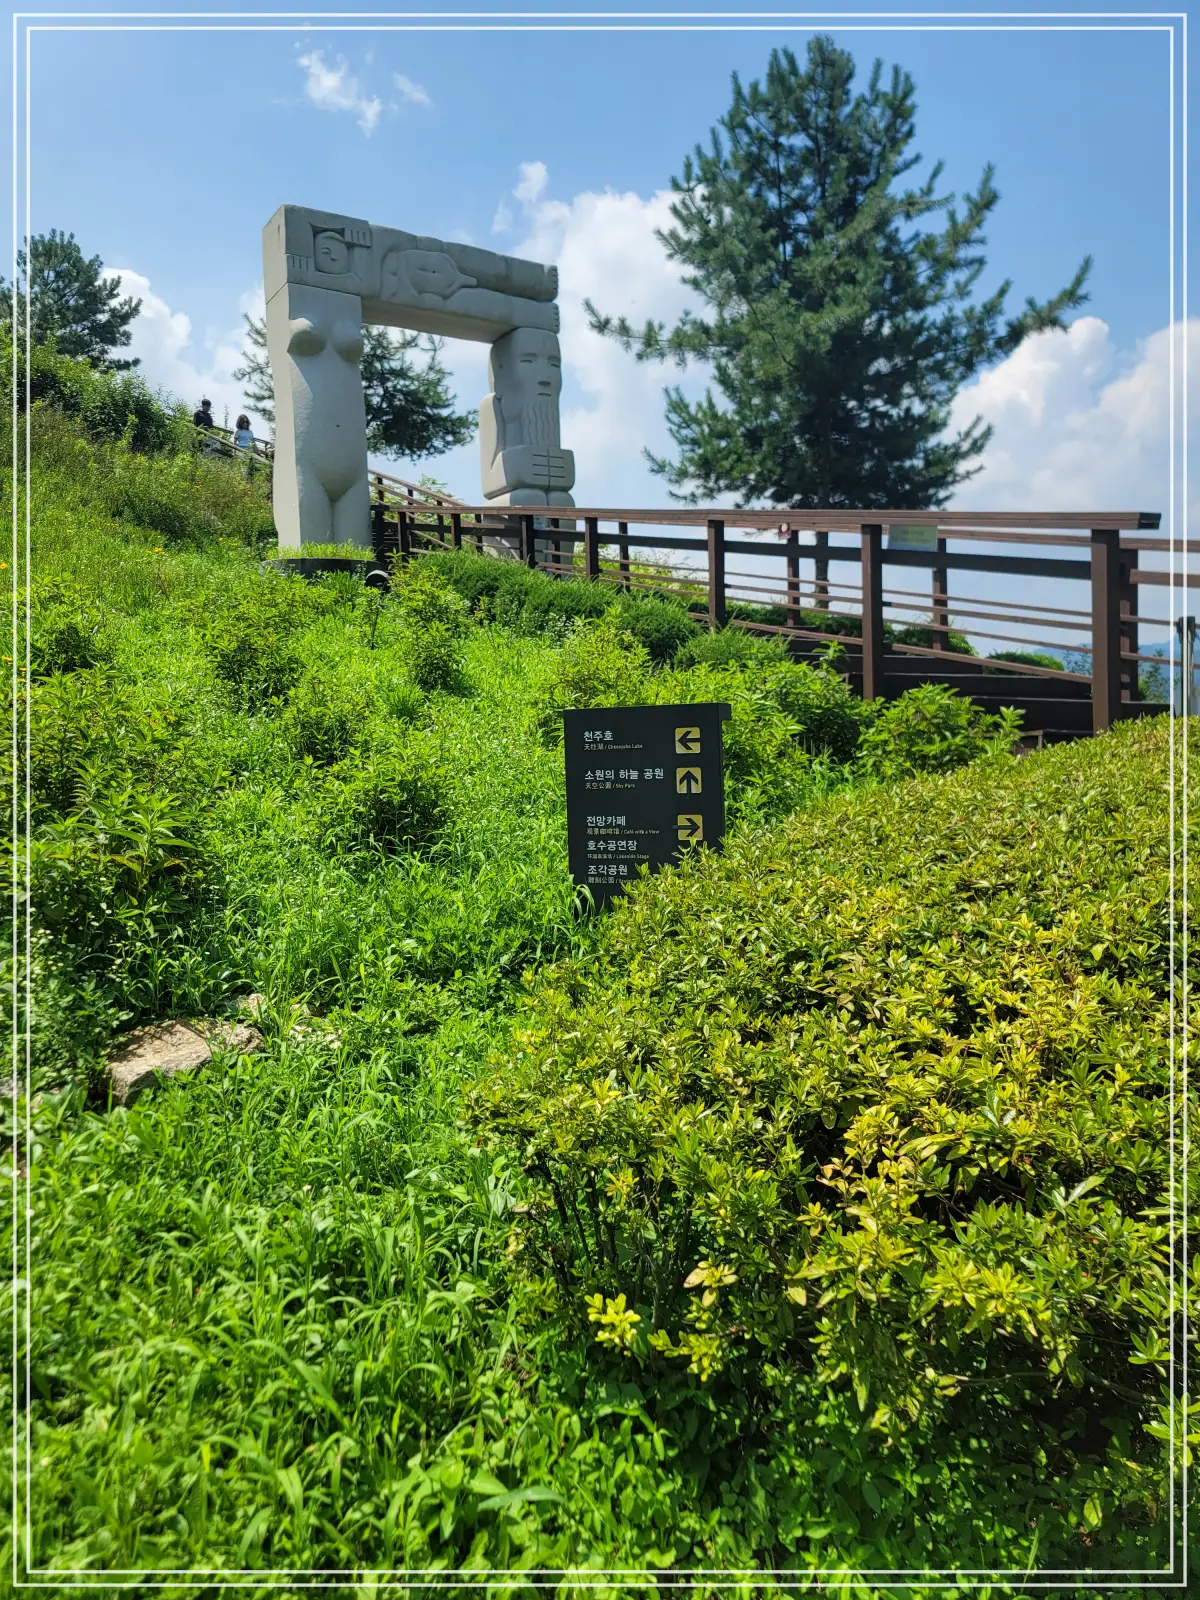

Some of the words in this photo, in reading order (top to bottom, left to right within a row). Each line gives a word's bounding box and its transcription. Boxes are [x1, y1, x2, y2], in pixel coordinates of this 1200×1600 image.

[583, 730, 614, 742] 천주호
[584, 769, 615, 780] 소원의
[618, 769, 639, 780] 하늘
[643, 768, 664, 779] 공원
[586, 815, 626, 827] 전망카페
[586, 840, 637, 851] 호수공연장
[587, 864, 628, 876] 조각공원
